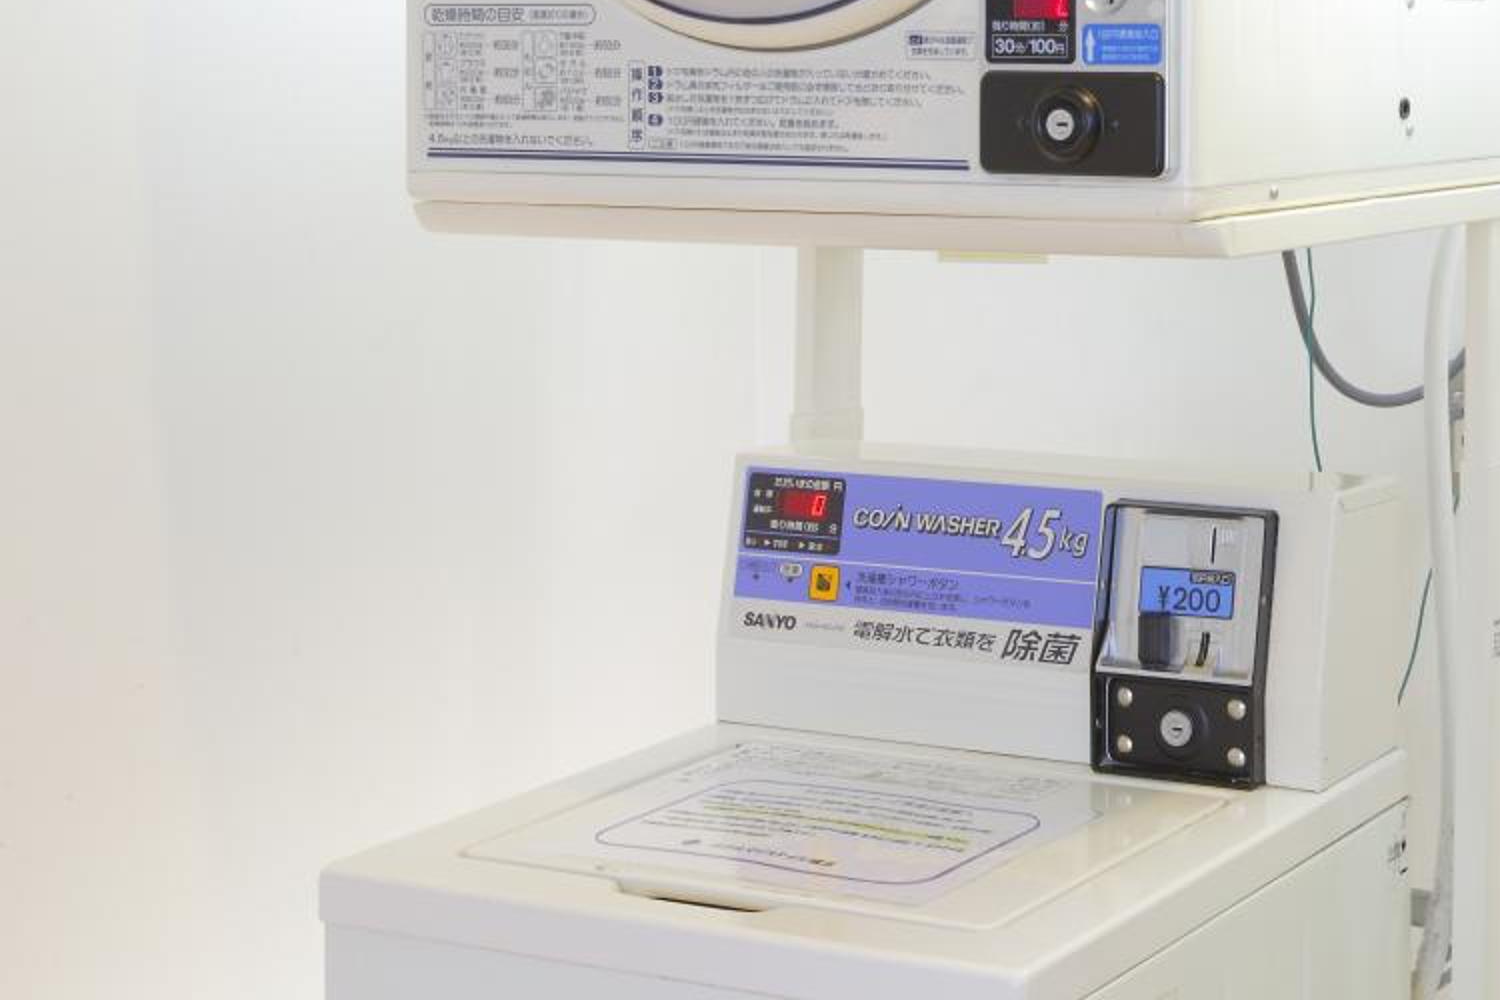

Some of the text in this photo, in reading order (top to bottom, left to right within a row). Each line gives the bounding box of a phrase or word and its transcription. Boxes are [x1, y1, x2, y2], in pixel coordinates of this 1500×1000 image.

[811, 495, 826, 516] 0
[915, 514, 1002, 538] WASHER
[1156, 584, 1222, 613] ¥200
[744, 611, 797, 630] SANYO
[1001, 628, 1082, 666] 除菌
